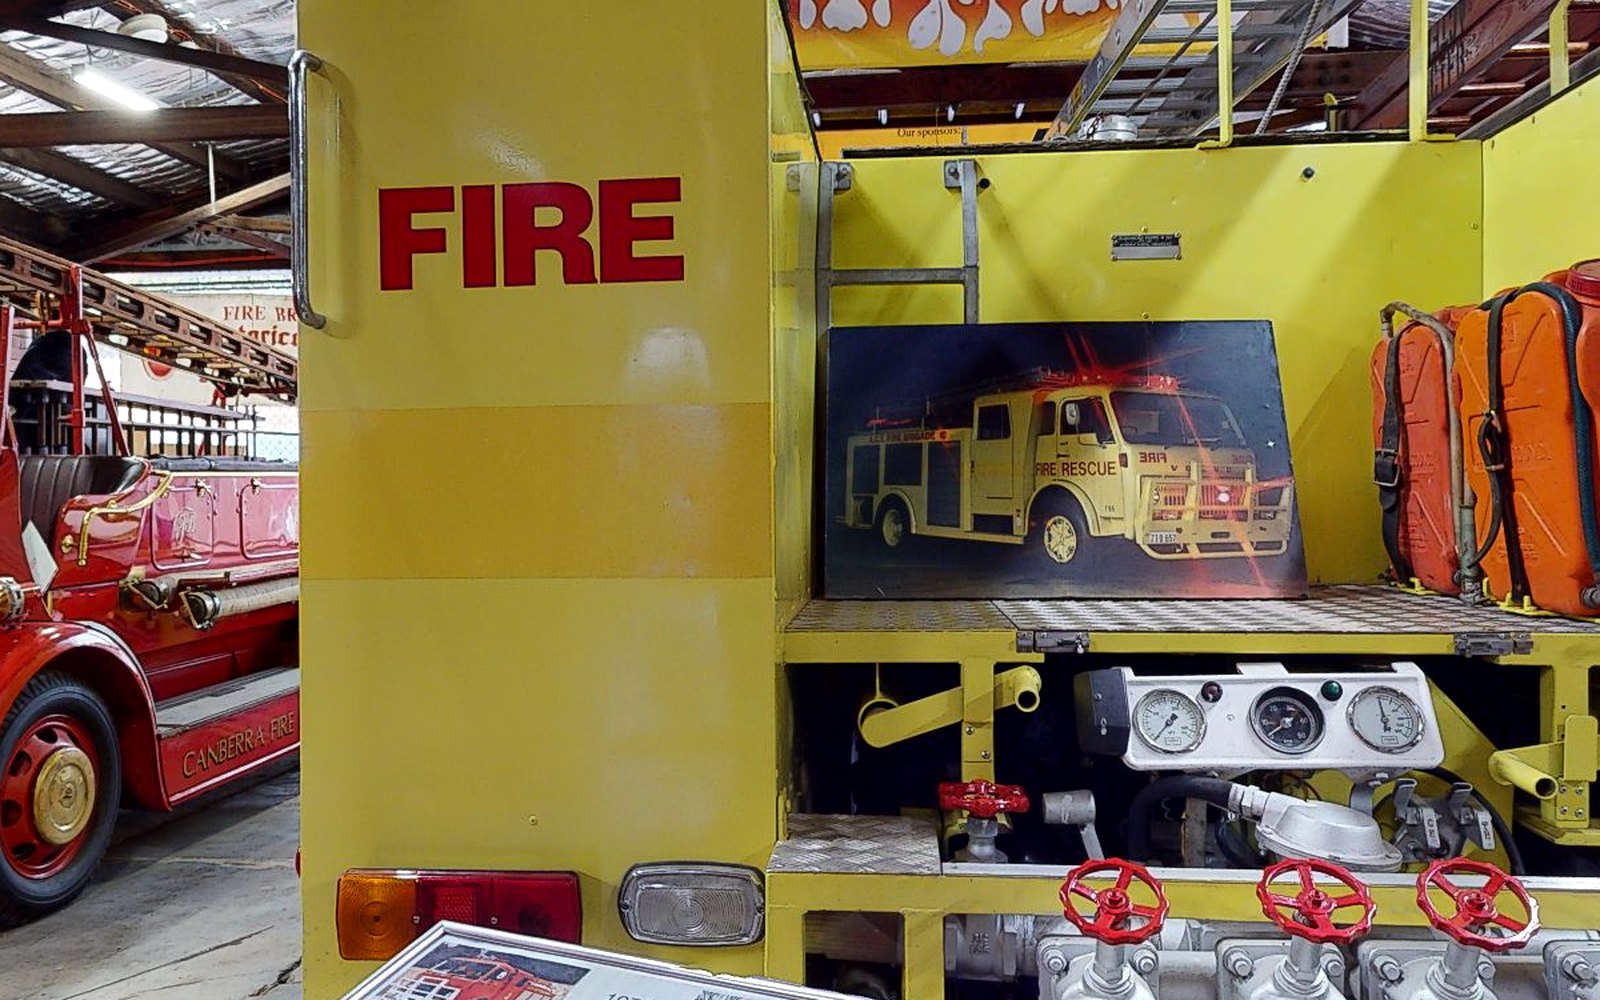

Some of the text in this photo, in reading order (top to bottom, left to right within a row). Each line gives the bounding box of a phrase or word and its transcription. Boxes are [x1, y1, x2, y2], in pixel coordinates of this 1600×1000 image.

[897, 128, 914, 137] Our
[379, 177, 685, 291] FIRE
[223, 305, 297, 322] FIRE BR
[1035, 461, 1117, 476] FIRE RESCUE
[183, 711, 295, 777] CANBERRA FIRE
